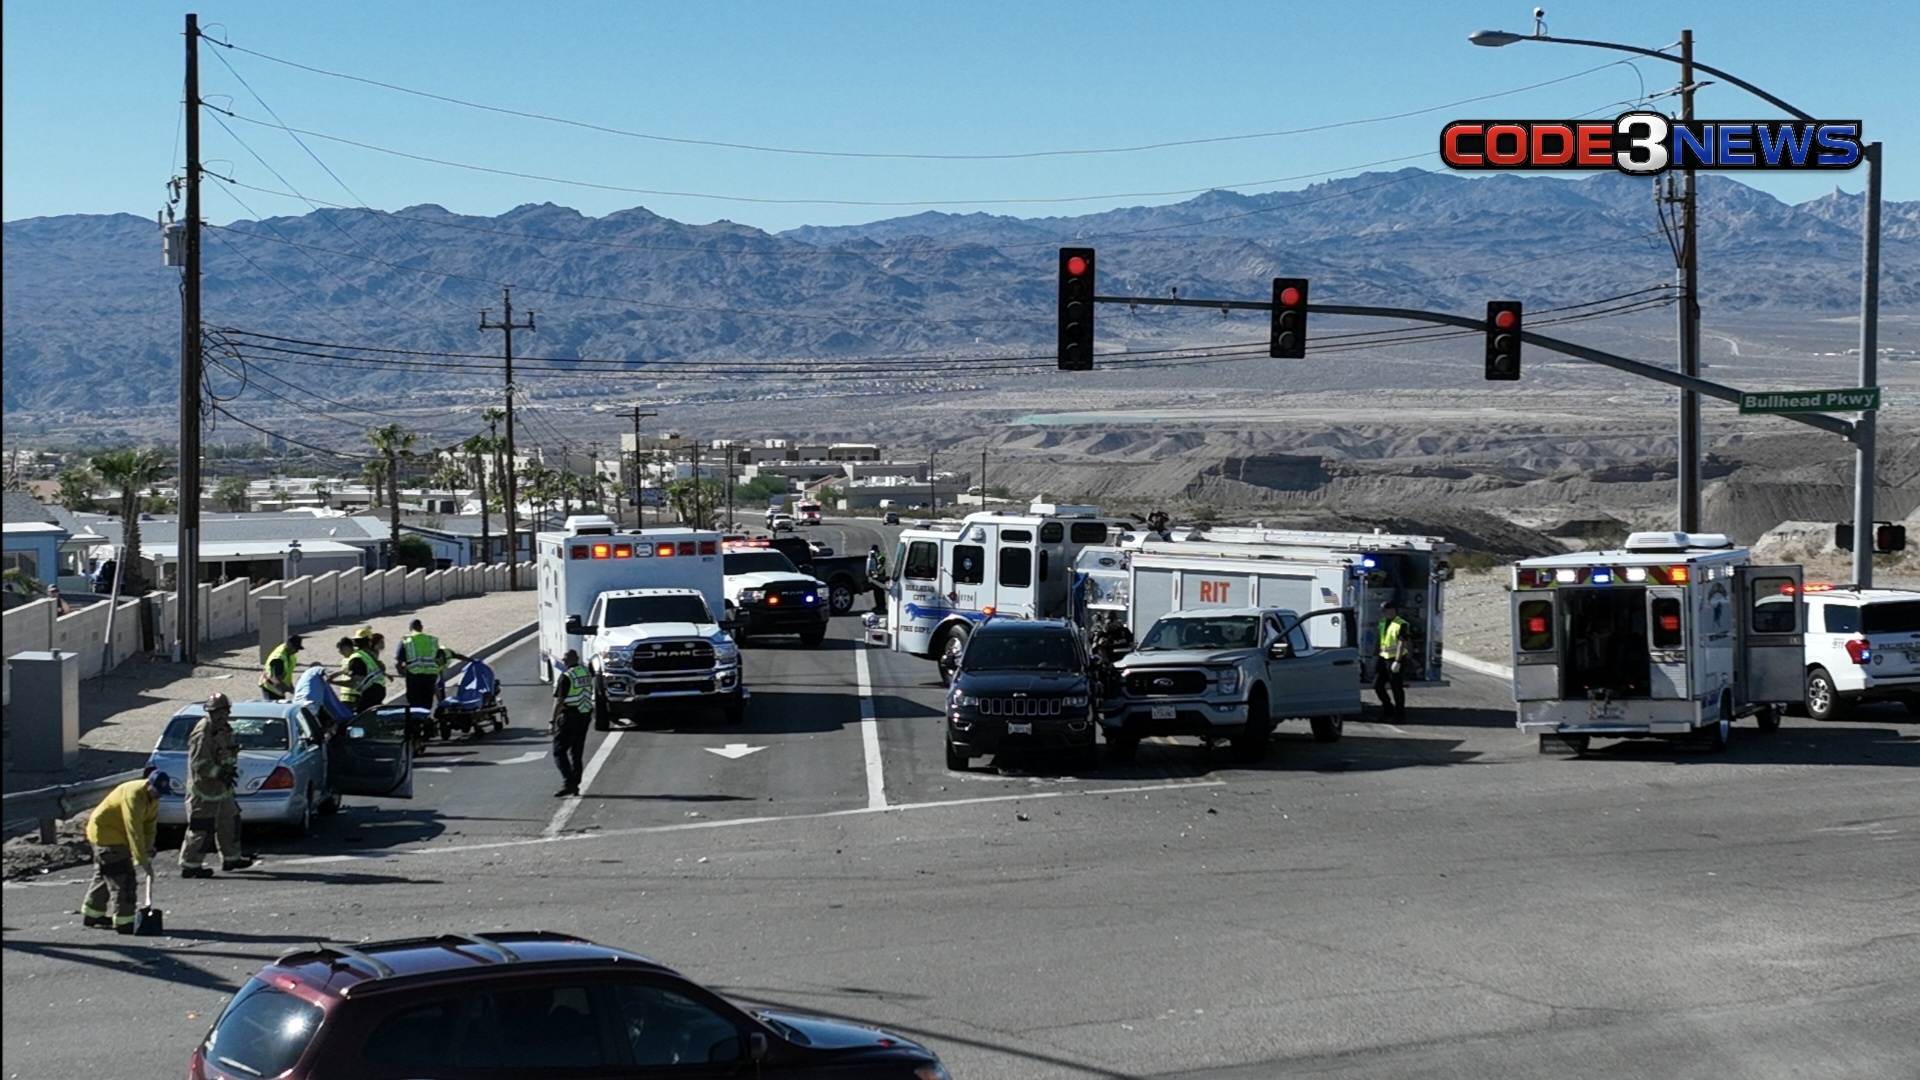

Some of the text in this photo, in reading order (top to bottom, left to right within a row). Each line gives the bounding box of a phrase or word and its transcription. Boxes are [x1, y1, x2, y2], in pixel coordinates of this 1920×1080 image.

[1744, 393, 1875, 408] Bullhead Pkwy
[1200, 581, 1230, 603] RIT
